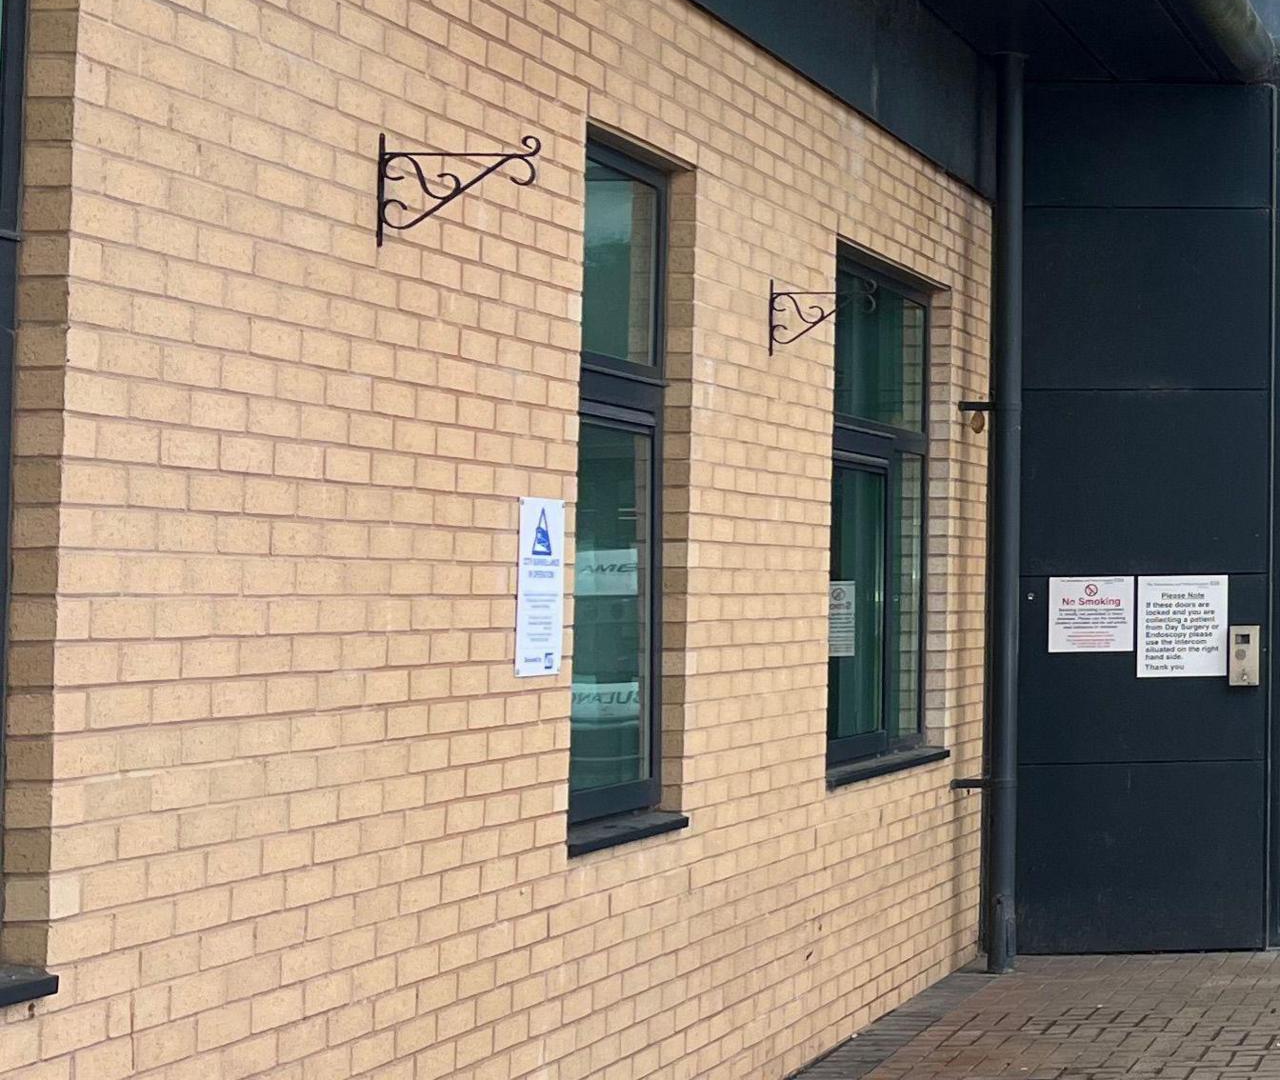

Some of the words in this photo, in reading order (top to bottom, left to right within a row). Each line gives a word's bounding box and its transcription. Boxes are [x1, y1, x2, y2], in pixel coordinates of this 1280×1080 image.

[1187, 591, 1205, 599] Note
[1062, 597, 1076, 606] No
[1078, 596, 1121, 608] Smoking
[1145, 616, 1182, 624] collecting
[1190, 616, 1215, 624] patient
[1181, 623, 1209, 631] Surgery
[1201, 645, 1219, 653] right
